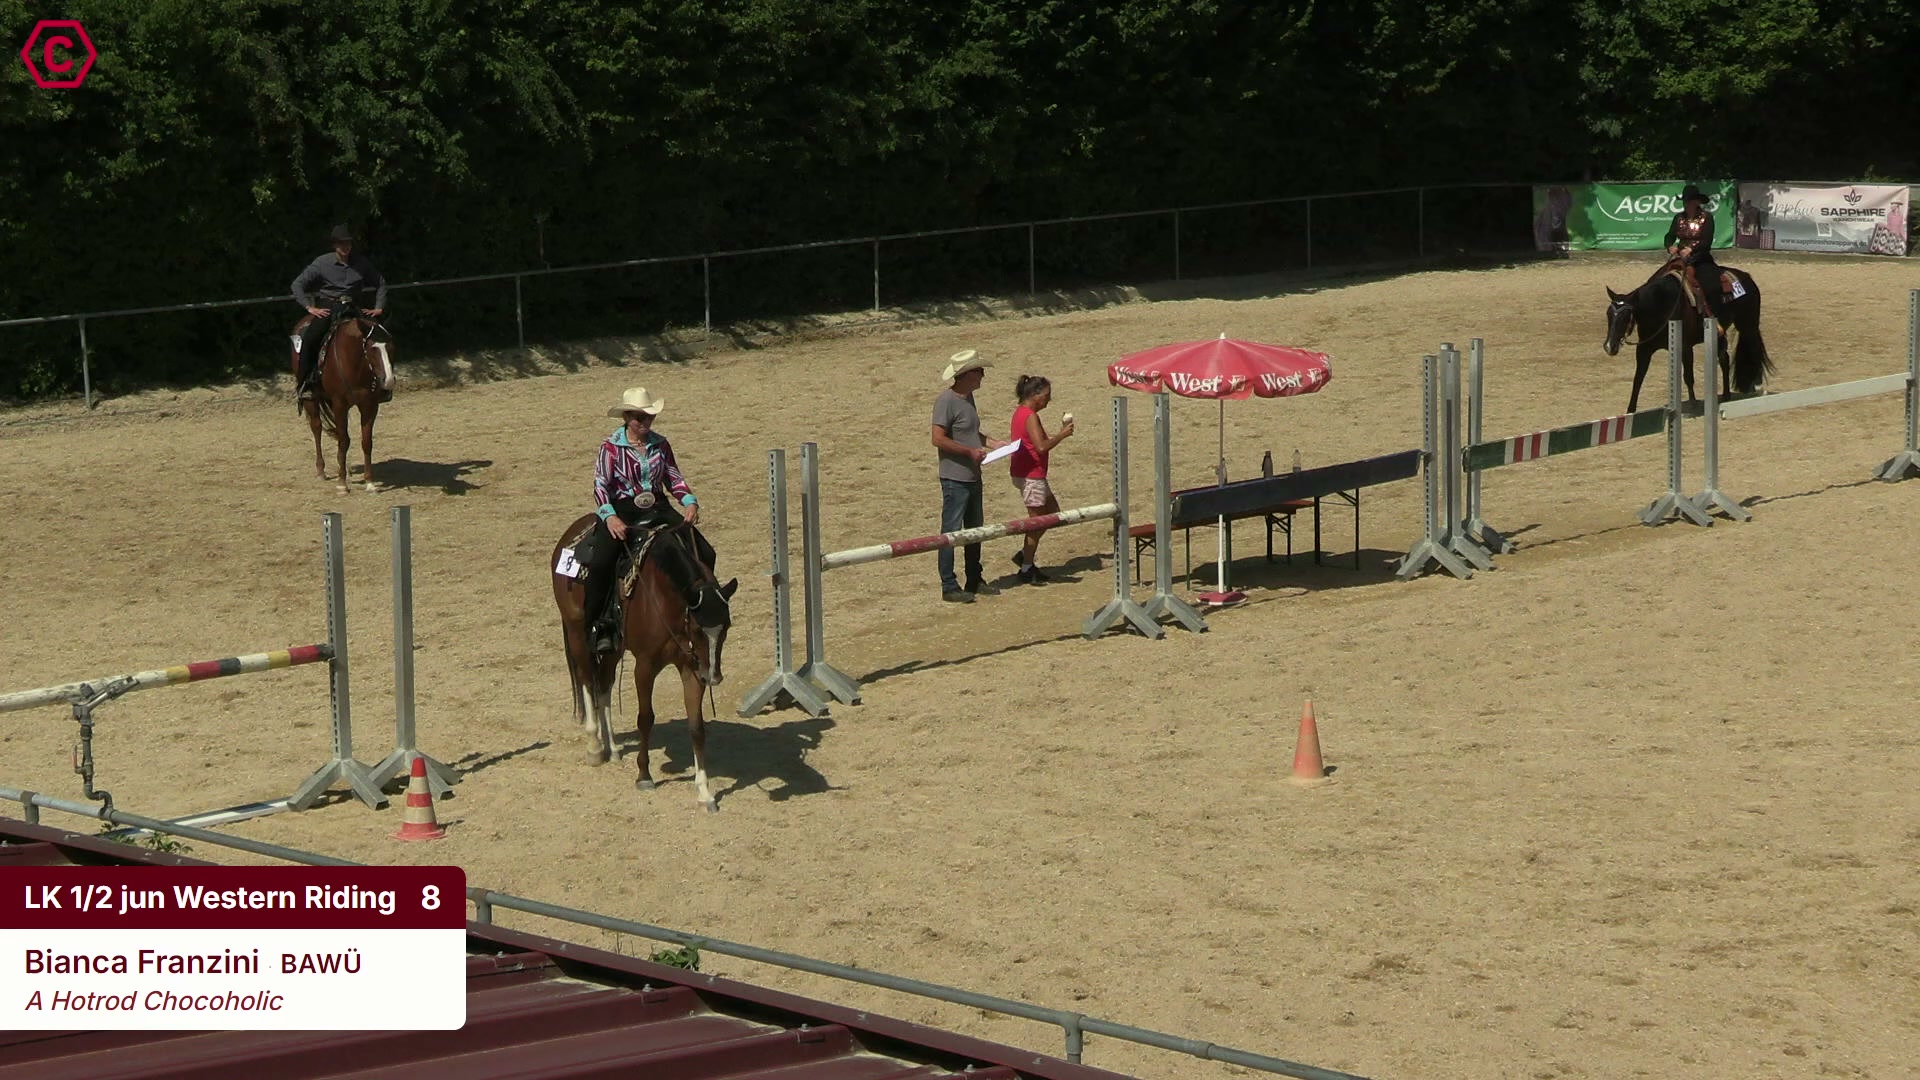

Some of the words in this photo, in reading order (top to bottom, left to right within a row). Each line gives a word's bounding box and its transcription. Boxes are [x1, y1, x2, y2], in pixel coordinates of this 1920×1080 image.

[1614, 194, 1721, 215] AGROS
[1820, 207, 1886, 217] SAPPHIRE
[1170, 372, 1223, 394] West
[1260, 370, 1303, 391] West
